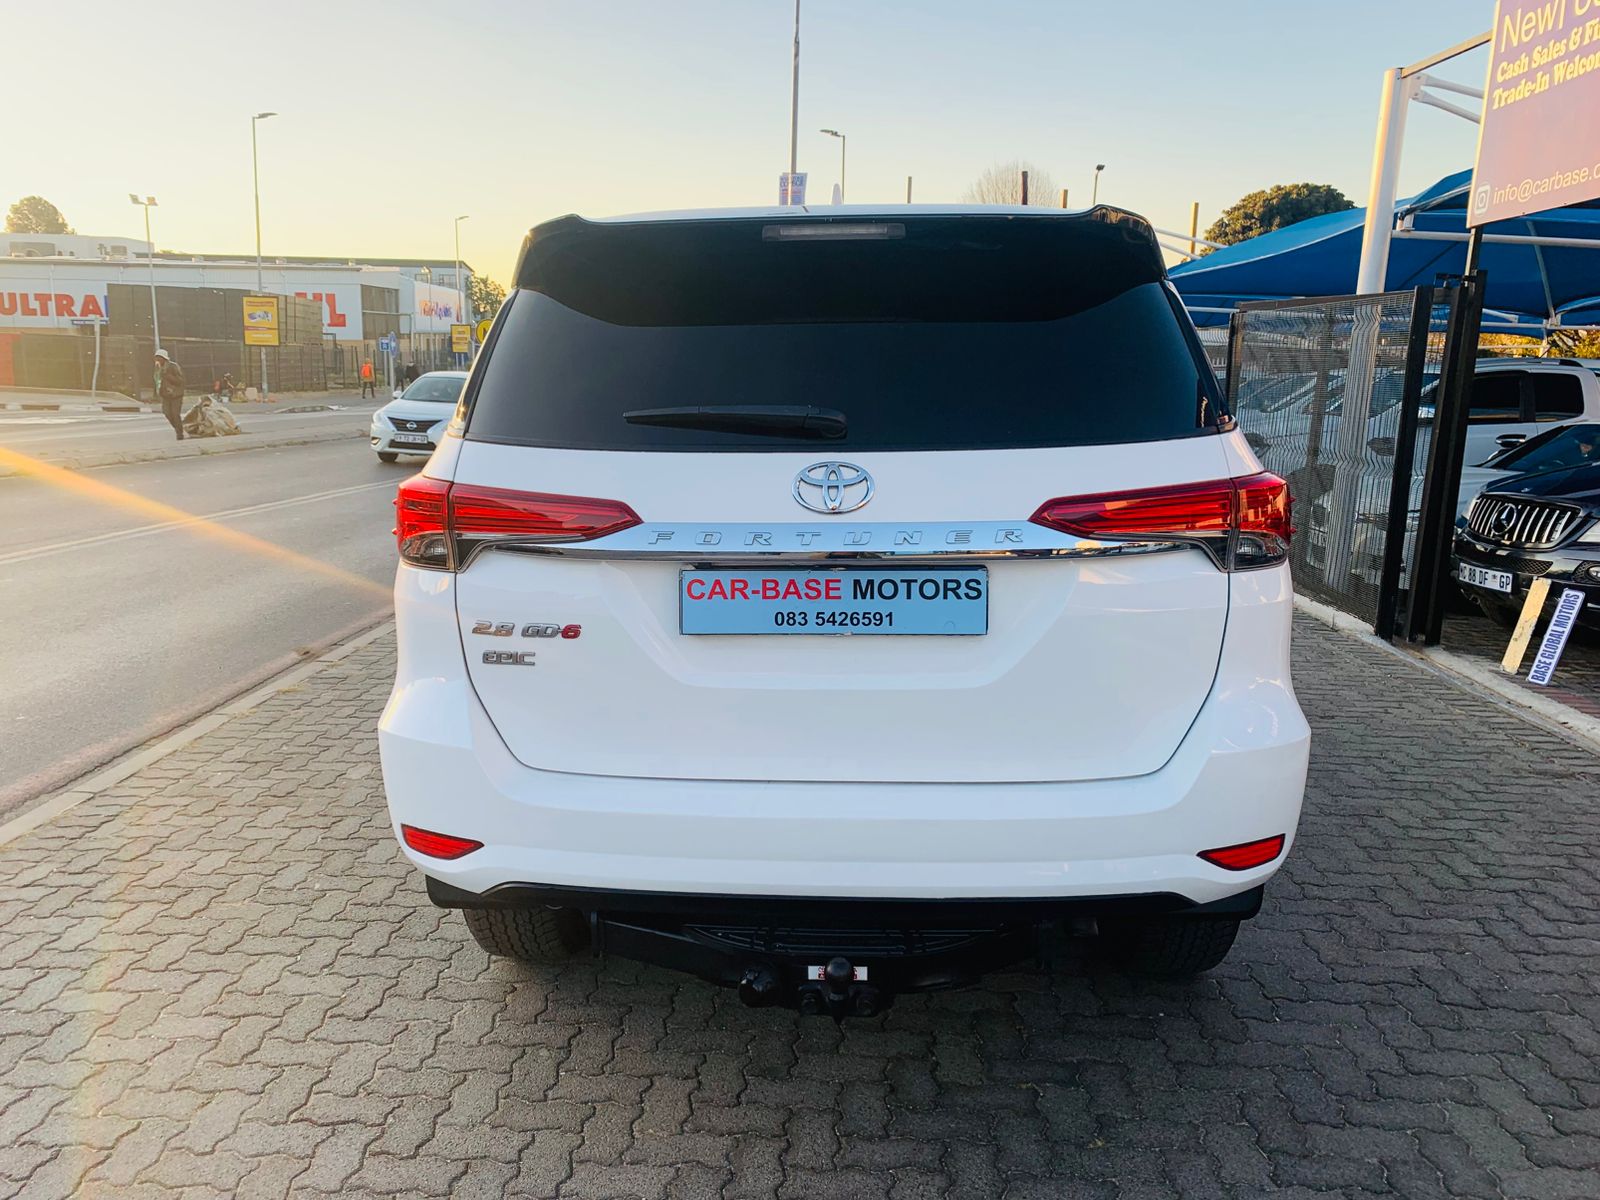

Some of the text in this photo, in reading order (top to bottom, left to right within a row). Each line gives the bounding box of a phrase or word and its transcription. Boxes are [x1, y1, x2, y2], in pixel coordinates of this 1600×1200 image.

[1497, 52, 1529, 83] Cash
[1531, 38, 1567, 69] Sales
[1569, 26, 1583, 52] &
[1492, 71, 1550, 110] Trade-In
[0, 292, 104, 318] ULTRA
[648, 528, 1024, 546] FORTUNER
[686, 578, 983, 600] CAR-BASE MOTORS
[1499, 574, 1511, 591] GP
[774, 611, 893, 627] 083 5426591
[521, 622, 582, 640] GD-6
[1531, 593, 1580, 682] BASE GLOBAL MOTORS
[482, 649, 536, 666] EPIC
